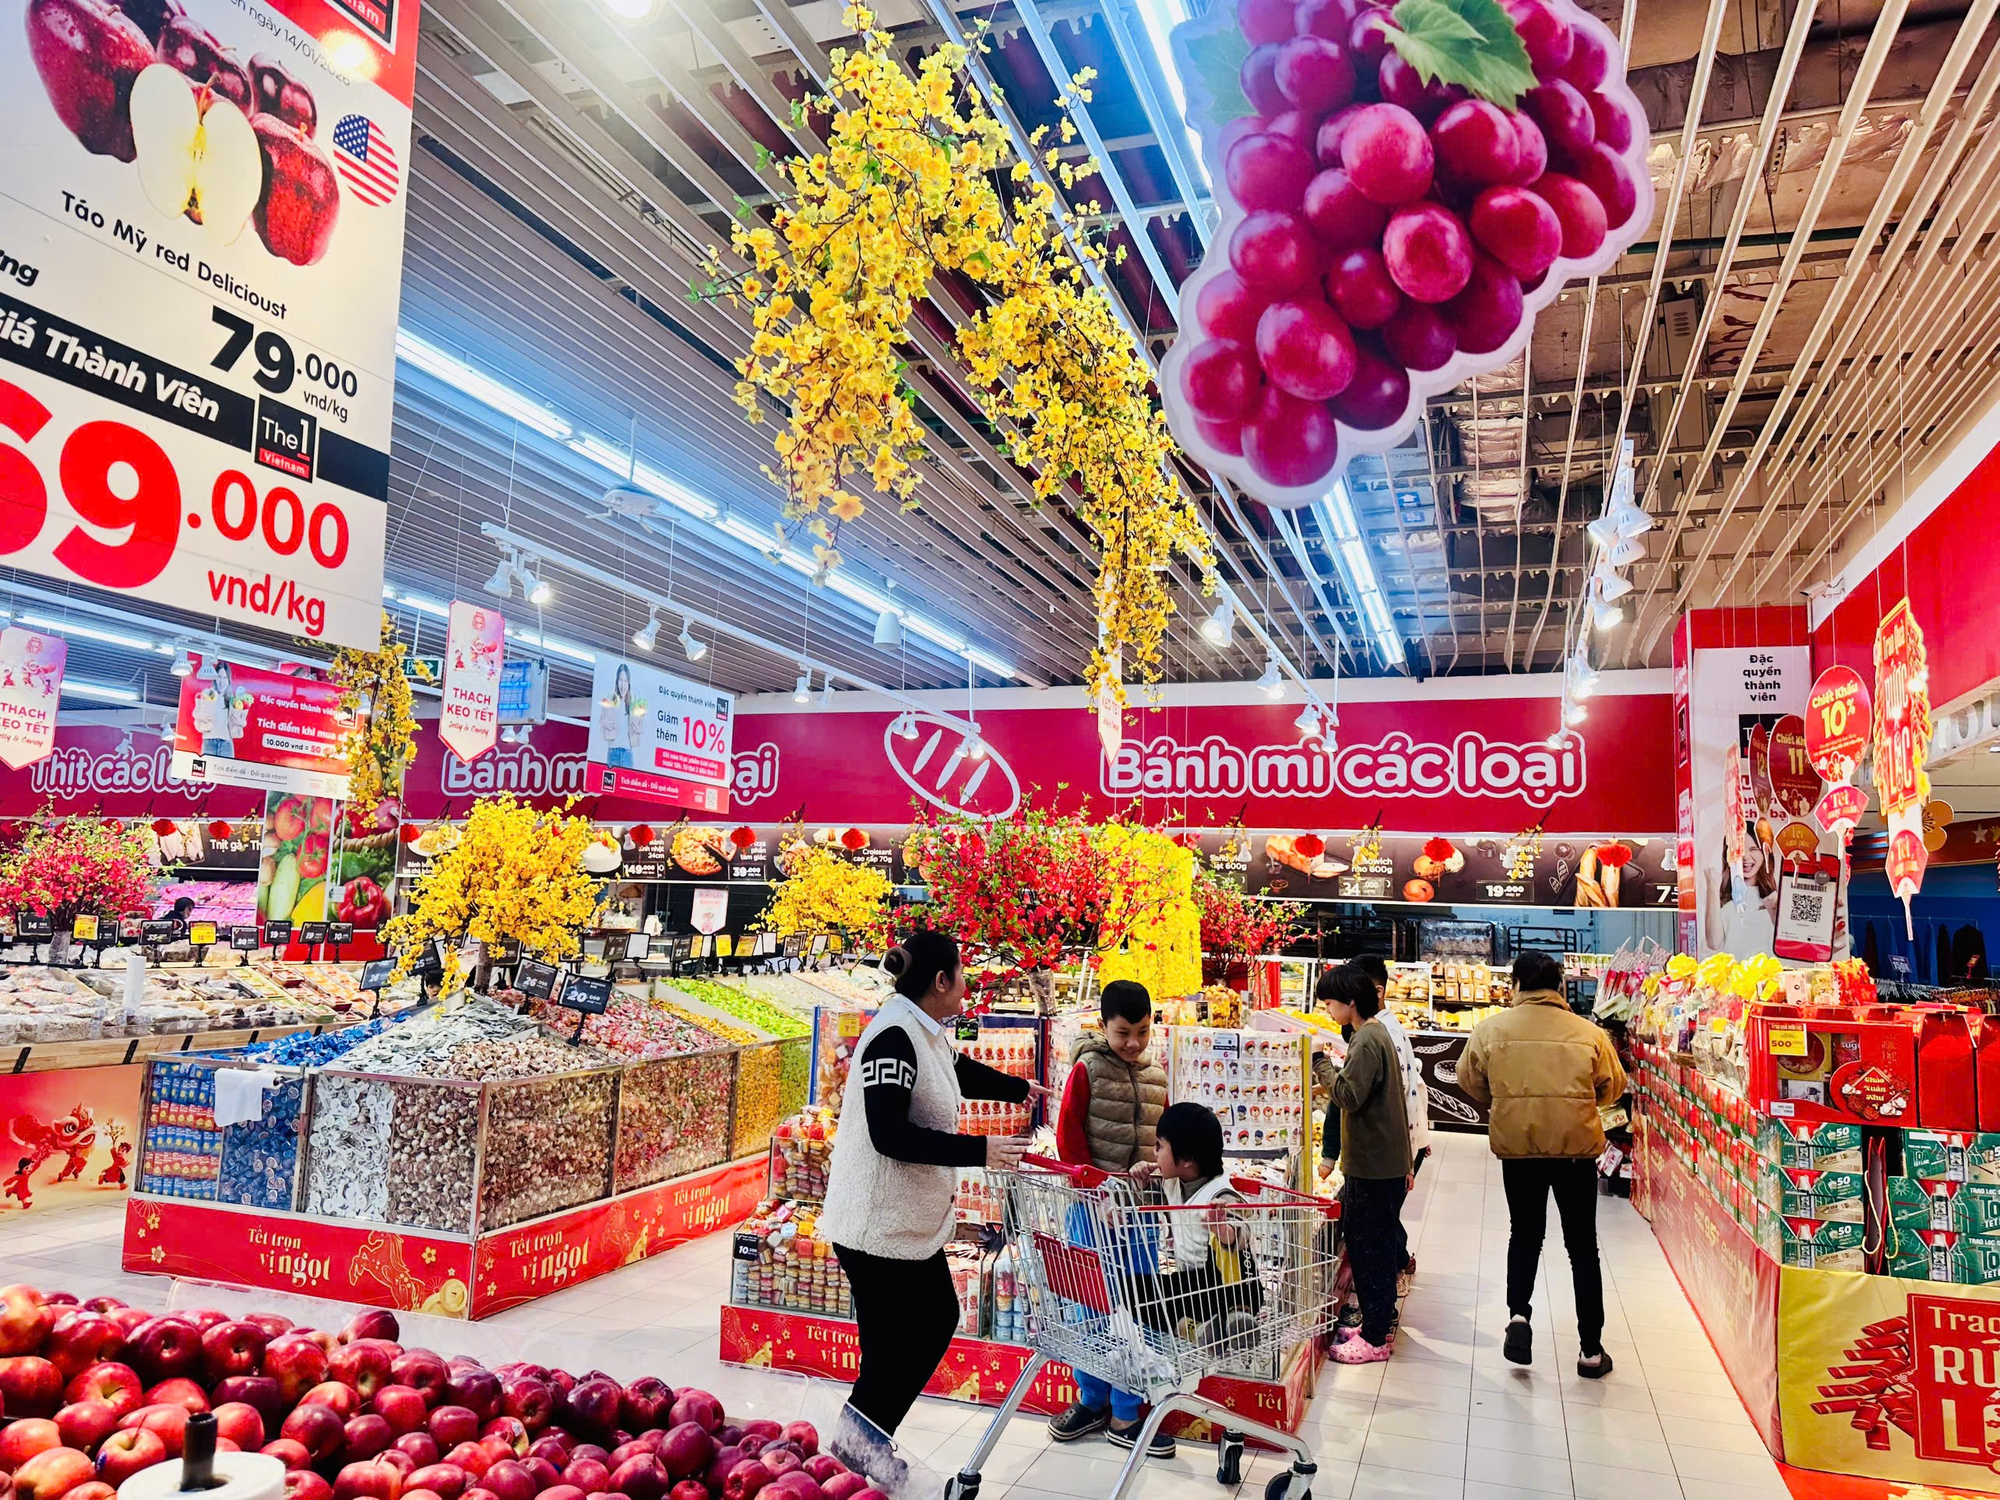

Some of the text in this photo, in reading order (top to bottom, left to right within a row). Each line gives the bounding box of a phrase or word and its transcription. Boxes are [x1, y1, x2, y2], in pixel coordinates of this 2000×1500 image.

[249, 7, 281, 37] ngày
[62, 190, 288, 320] Táo Mỹ red Delicioust
[0, 249, 39, 288] ng
[45, 328, 147, 394] Thành
[155, 370, 221, 423] Viên
[303, 390, 349, 424] vnd/kg
[263, 449, 306, 477] Vietnam
[207, 570, 326, 636] vnd/kg
[1749, 654, 1774, 666] Đặc
[1743, 666, 1782, 679] quyền
[658, 686, 669, 697] Đặc
[1744, 680, 1781, 691] thành
[1812, 679, 1859, 709] Chiết Khấu
[453, 687, 491, 705] THẠCH
[1750, 693, 1777, 702] viên
[0, 702, 46, 720] THẠCH
[446, 703, 494, 722] KẸO TẾT
[657, 710, 679, 726] Giảm
[1821, 698, 1856, 740] 10%
[25, 720, 49, 735] TẾT
[257, 718, 277, 730] Tích
[278, 720, 300, 734] điểm
[302, 724, 316, 737] khi
[317, 730, 337, 741] mua
[656, 728, 678, 743] thêm
[682, 716, 726, 754] 10%
[266, 737, 290, 750] 10.000
[310, 745, 322, 755] 50
[1776, 732, 1795, 746] Chiết
[1796, 735, 1807, 746] Kh
[94, 746, 150, 791] các
[1108, 736, 1580, 802] Bánh mì các loại
[647, 852, 665, 860] 24cm
[862, 848, 893, 856] Croissant
[879, 856, 893, 864] 70g
[732, 867, 761, 877] 39.000
[1225, 863, 1247, 872] 600g
[1369, 865, 1393, 875] 600g
[1485, 885, 1525, 897] 19.000
[1836, 1126, 1850, 1137] 50
[1837, 1175, 1851, 1186] 50
[673, 1183, 711, 1208] Tết trọn
[682, 1191, 731, 1232] vị ngọt
[248, 1224, 302, 1252] Tết trọn
[1838, 1225, 1852, 1236] 50
[509, 1229, 563, 1259] Tết trọn
[260, 1249, 331, 1288] vị ngọt
[522, 1236, 590, 1286] vị ngọt
[805, 1322, 829, 1342] Tết
[821, 1347, 837, 1369] vị
[1046, 1361, 1072, 1383] trọ
[1035, 1378, 1052, 1403] vị
[1254, 1388, 1282, 1411] Tết
